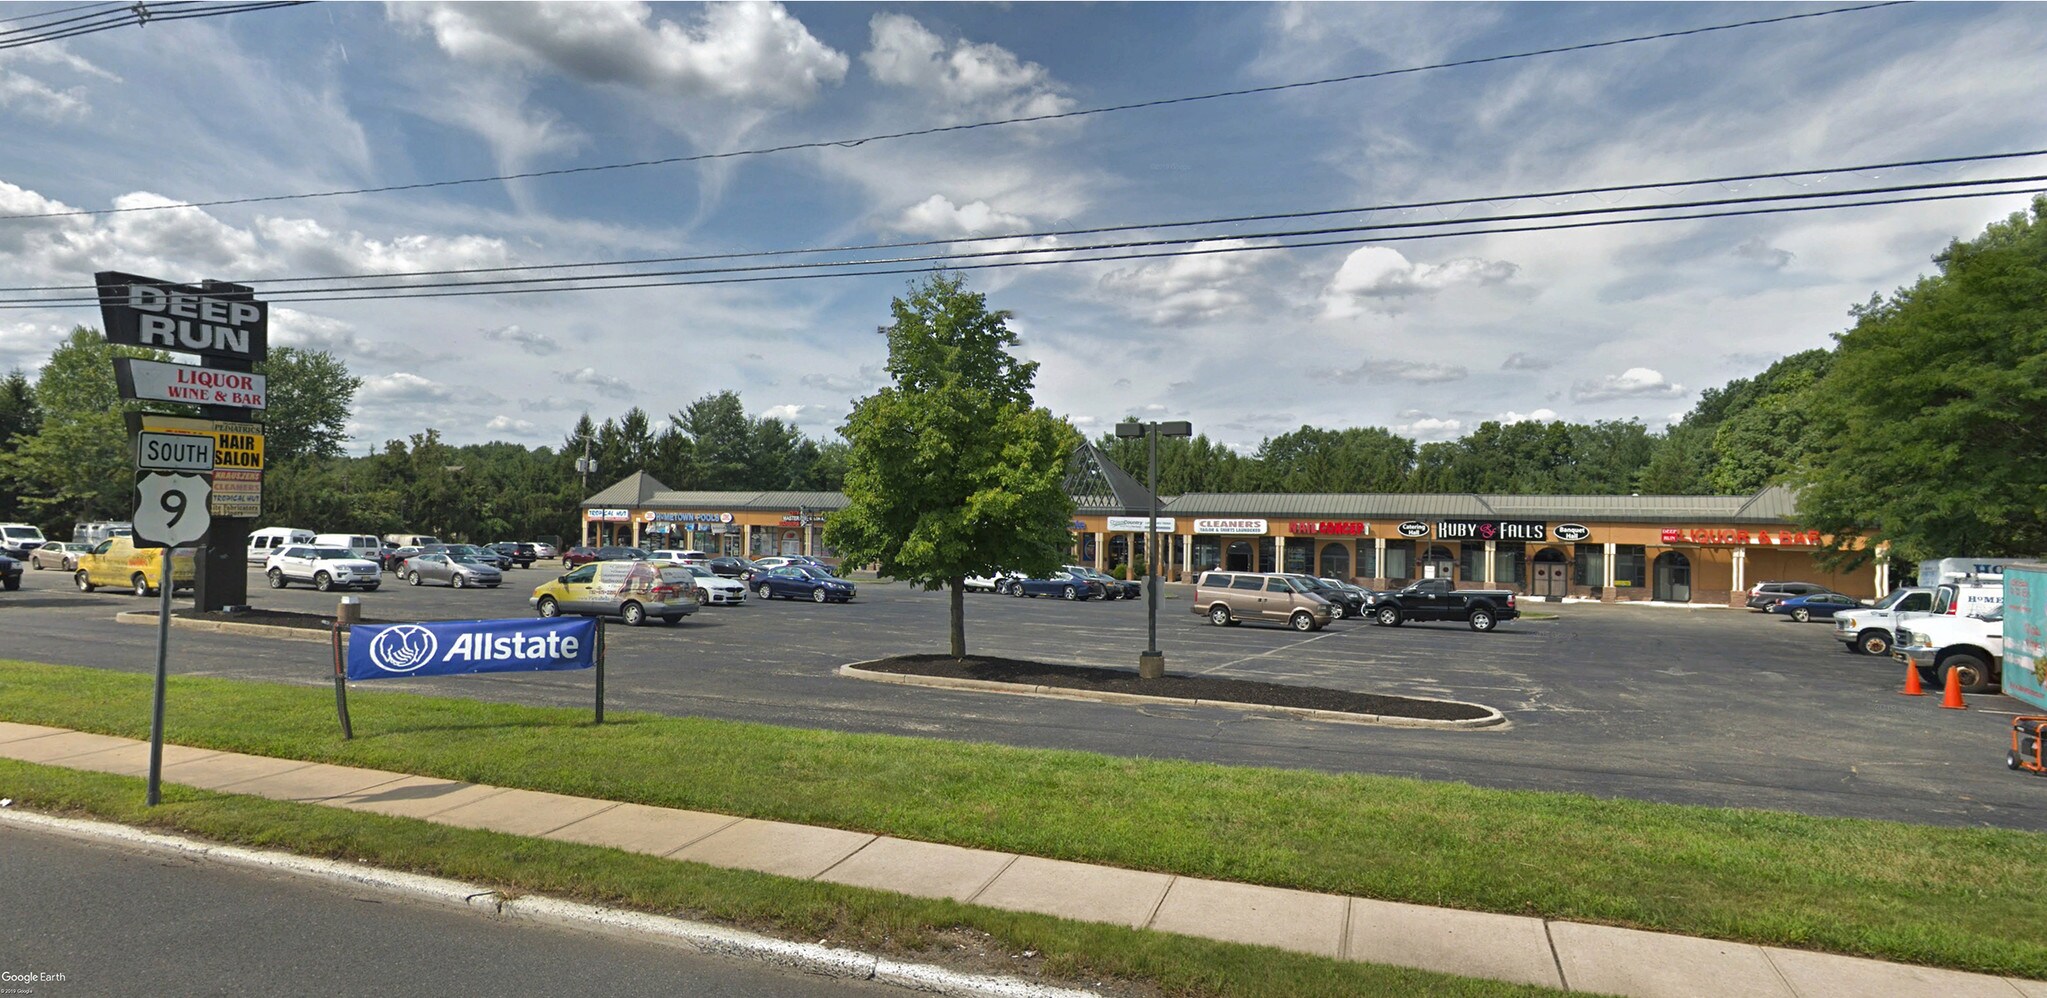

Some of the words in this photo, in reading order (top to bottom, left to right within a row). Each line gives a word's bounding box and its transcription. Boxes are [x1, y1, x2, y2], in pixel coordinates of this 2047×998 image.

[129, 283, 260, 326] DEEP
[141, 314, 249, 353] RUN
[177, 369, 253, 390] LIQUOR
[168, 386, 209, 400] WINE
[214, 391, 227, 402] &
[232, 393, 262, 405] BAR
[214, 423, 260, 433] PEDIATRICS
[219, 434, 254, 450] HAIR
[148, 440, 207, 463] SOUTH
[215, 450, 260, 467] SALON
[213, 483, 260, 491] CLEANERS
[161, 489, 187, 528] 9
[1199, 520, 1261, 528] CLEANERS
[1320, 521, 1371, 536] CONCEPT
[1402, 523, 1426, 531] Catering
[1500, 522, 1544, 539] FALLS
[1559, 526, 1586, 534] Banquet
[1679, 528, 1750, 545] LIQUOR
[1758, 530, 1773, 545] &
[1779, 530, 1821, 545] BAR
[442, 630, 580, 662] Allstate
